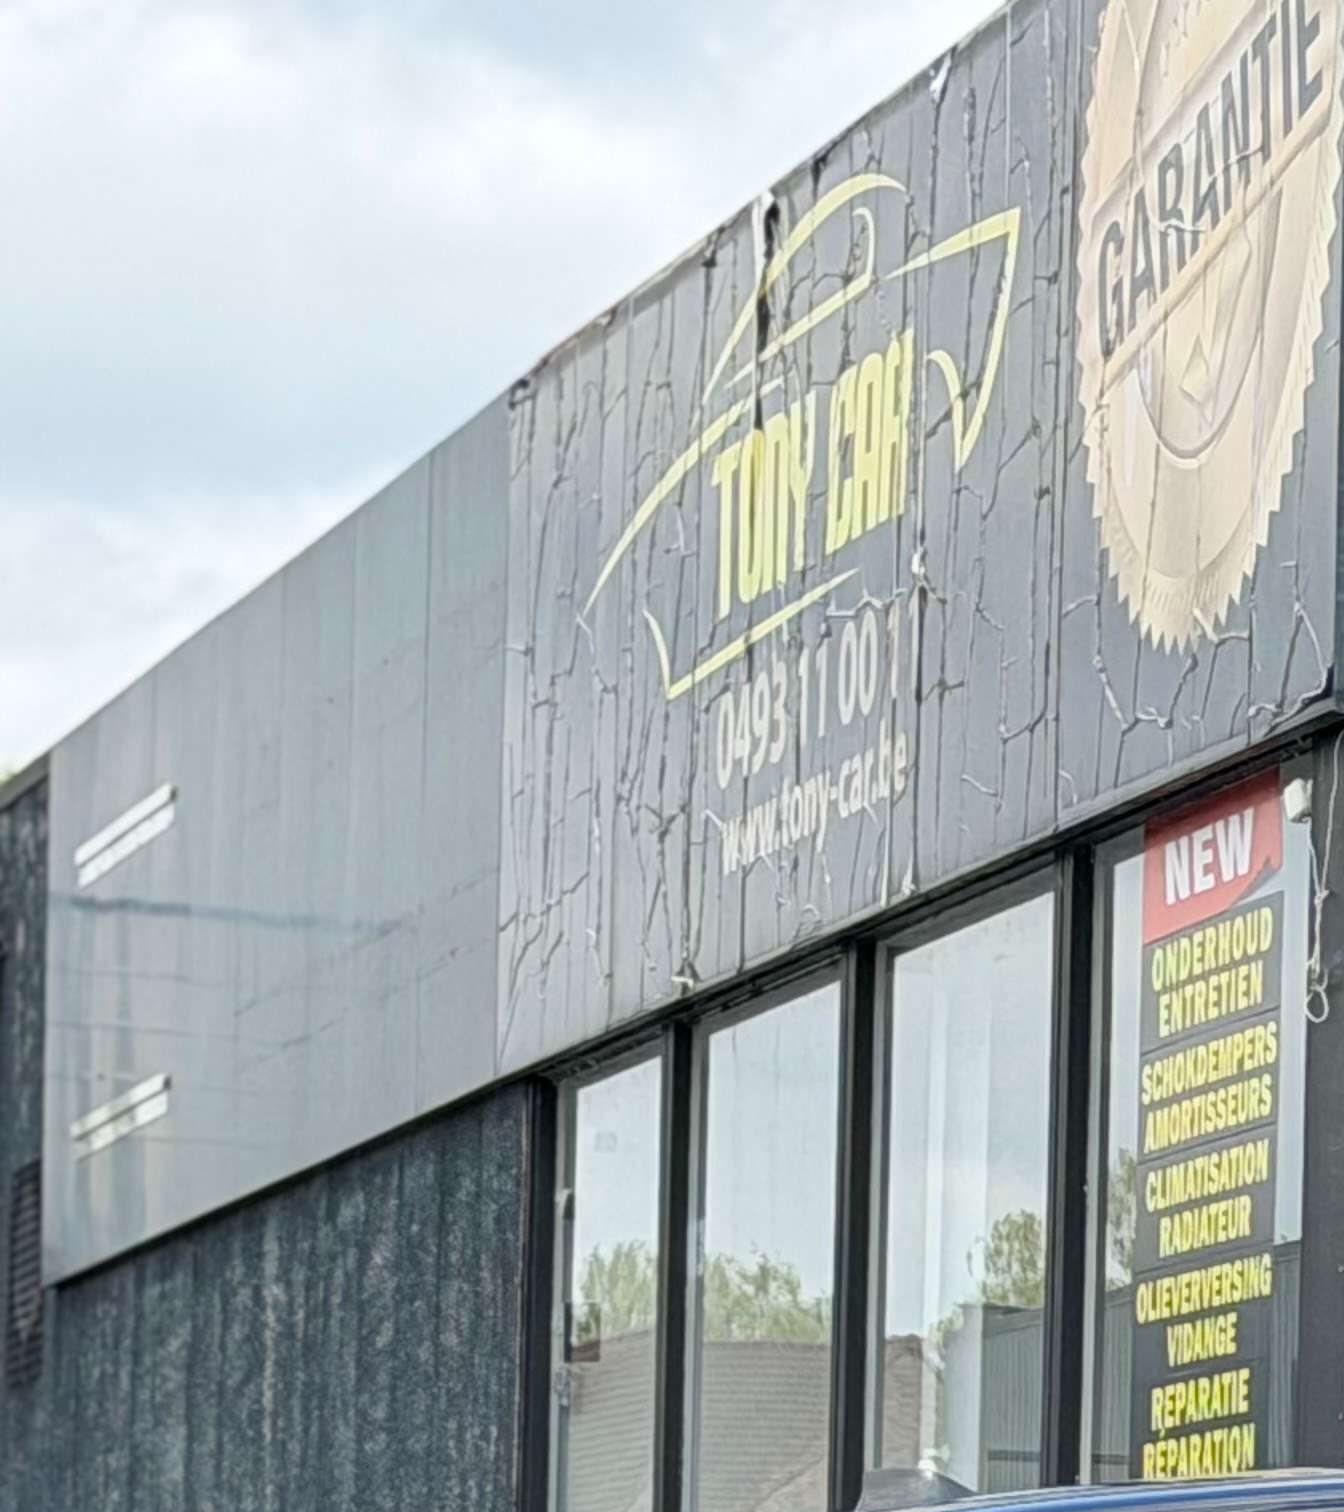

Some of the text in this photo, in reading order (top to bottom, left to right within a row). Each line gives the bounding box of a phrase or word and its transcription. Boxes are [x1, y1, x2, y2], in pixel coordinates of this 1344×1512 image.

[1099, 0, 1324, 361] GARANTIE
[711, 324, 914, 620] TONY CAR
[716, 661, 788, 790] 0493
[837, 609, 879, 725] 00
[720, 717, 909, 876] www.tony-car.be
[1164, 807, 1255, 906] NEW
[1151, 906, 1274, 992] ONDERHOUD
[1158, 959, 1264, 1038] ENTRETIEN
[1141, 1021, 1278, 1105] SCHOKDEMPERS
[1143, 1073, 1273, 1154] AMORTISSEURS
[1145, 1138, 1269, 1213] CLIMATISATION
[1159, 1195, 1252, 1258] RADIATEUR
[1136, 1253, 1273, 1324] OLIEVERVERSING
[1167, 1312, 1238, 1367] VIDANGE
[1151, 1368, 1251, 1431] REPARATIE
